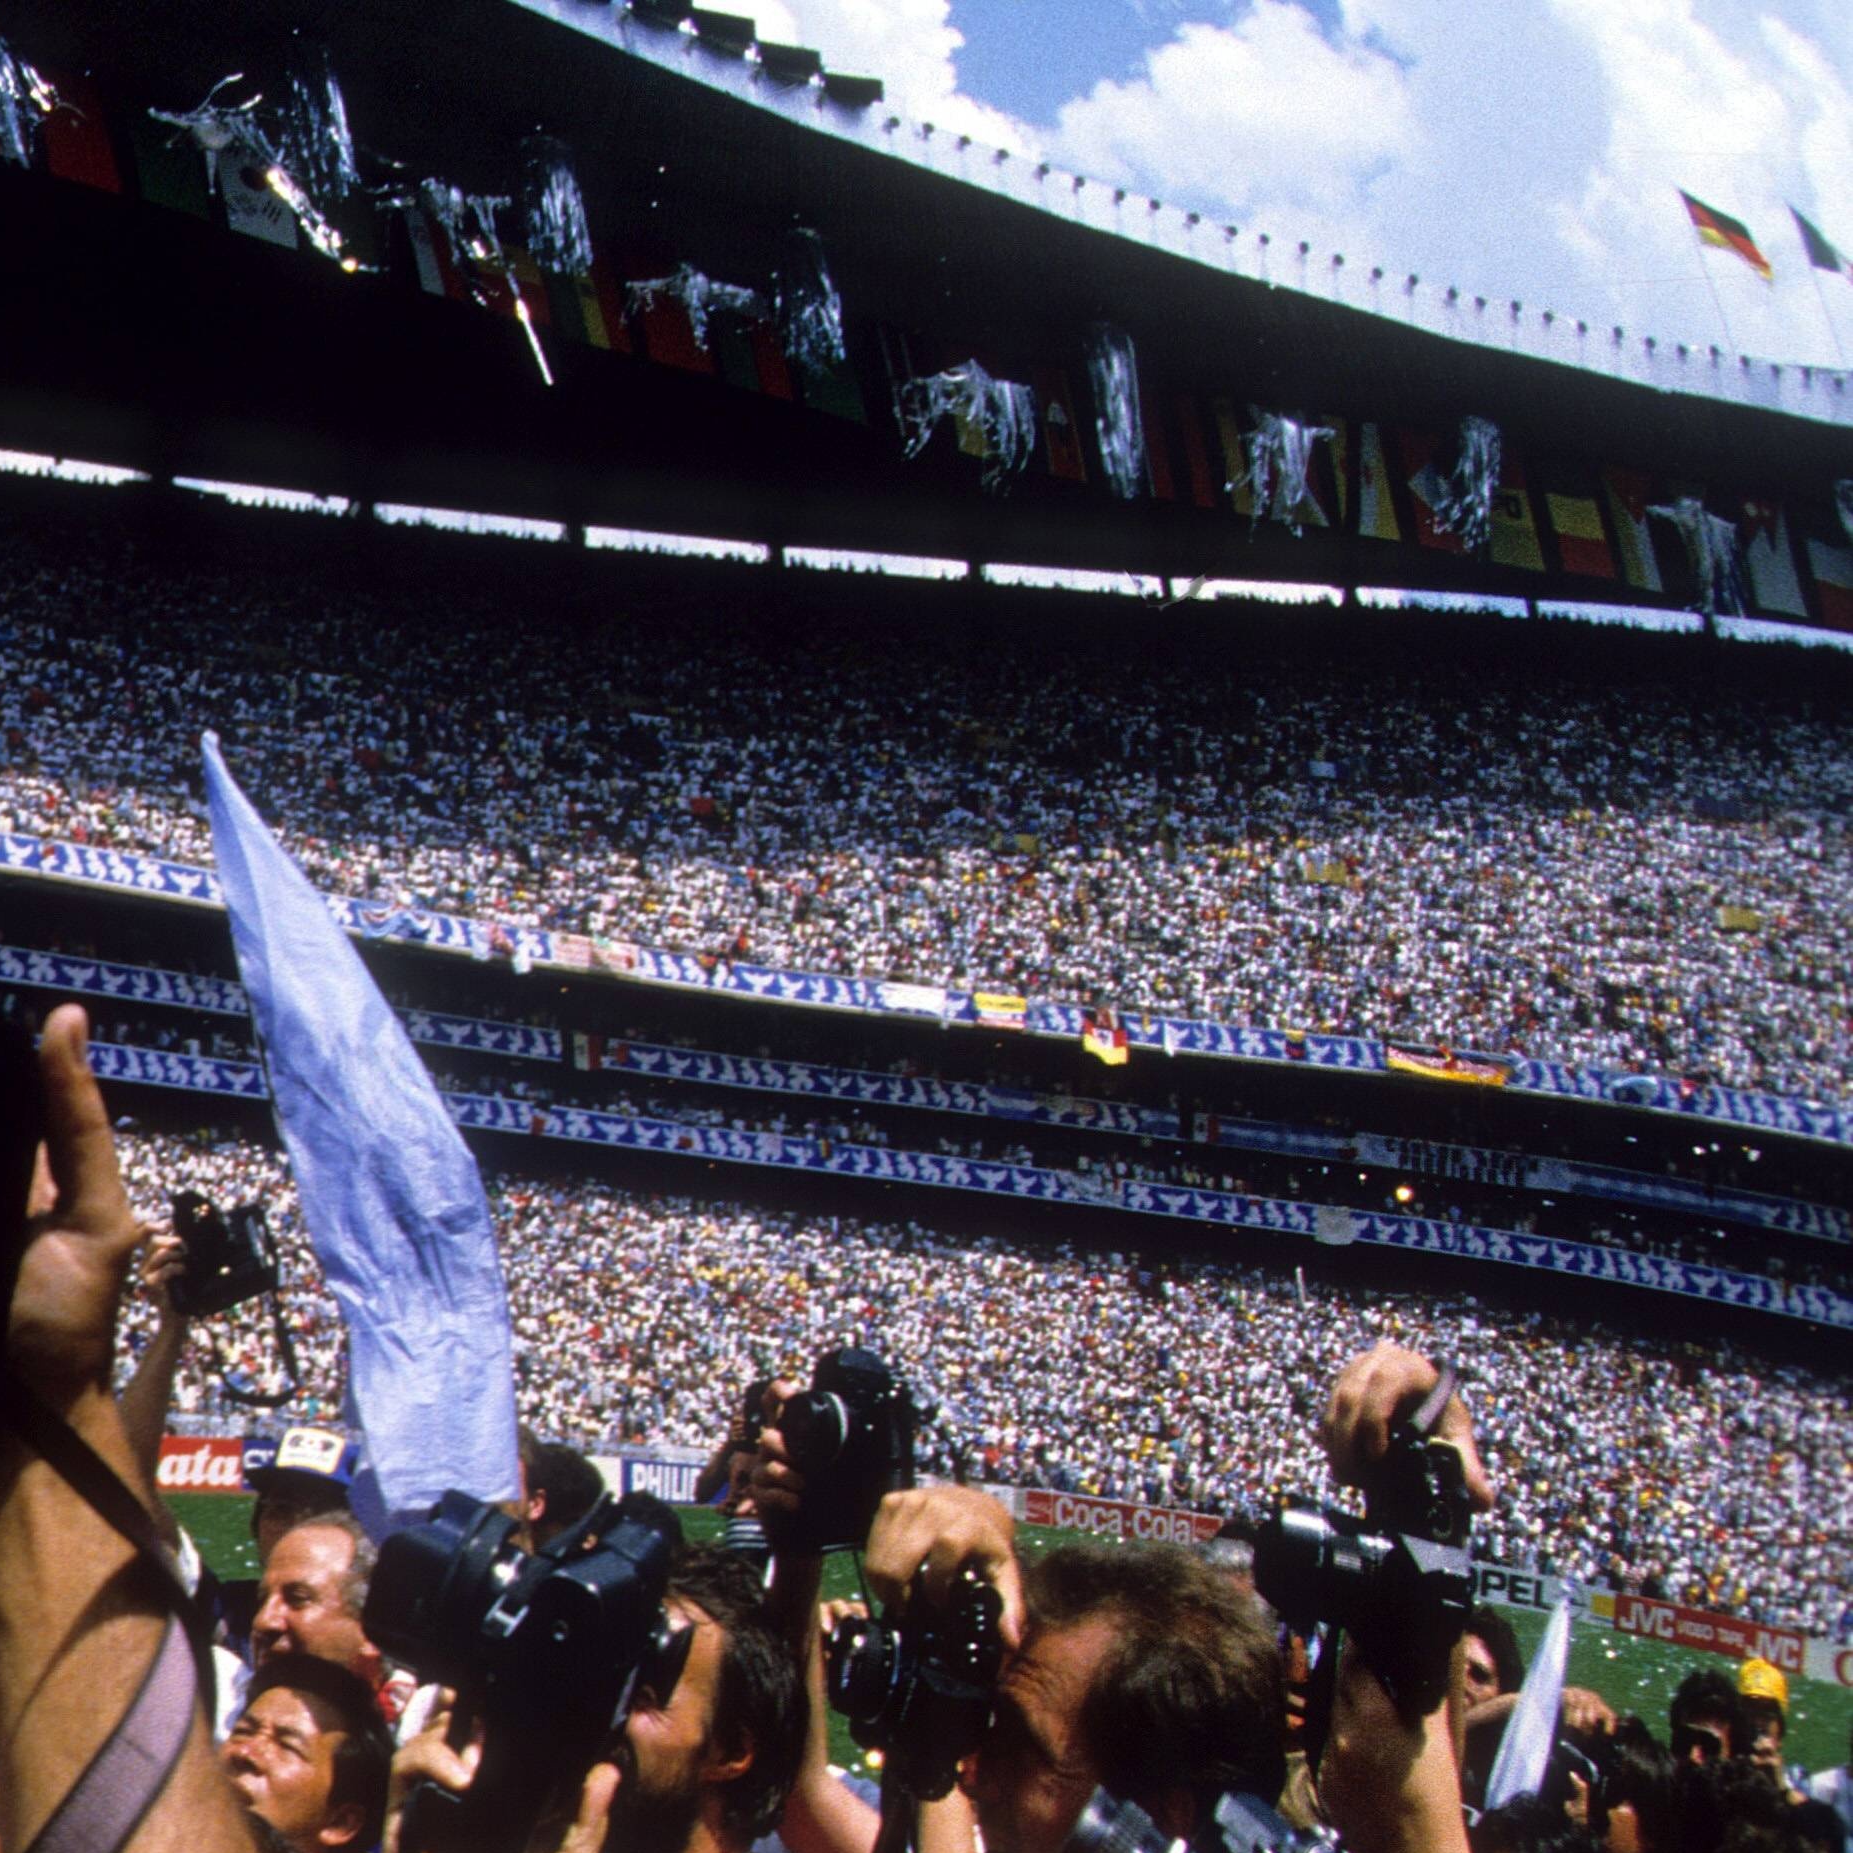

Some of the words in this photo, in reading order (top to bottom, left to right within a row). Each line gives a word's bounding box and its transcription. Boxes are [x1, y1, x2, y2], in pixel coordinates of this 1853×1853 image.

[156, 1443, 242, 1486] ata
[1055, 1497, 1191, 1545] Coca-Cola
[1472, 1568, 1552, 1611] PEL
[1619, 1601, 1675, 1638] JVC
[1746, 1631, 1799, 1669] JVC
